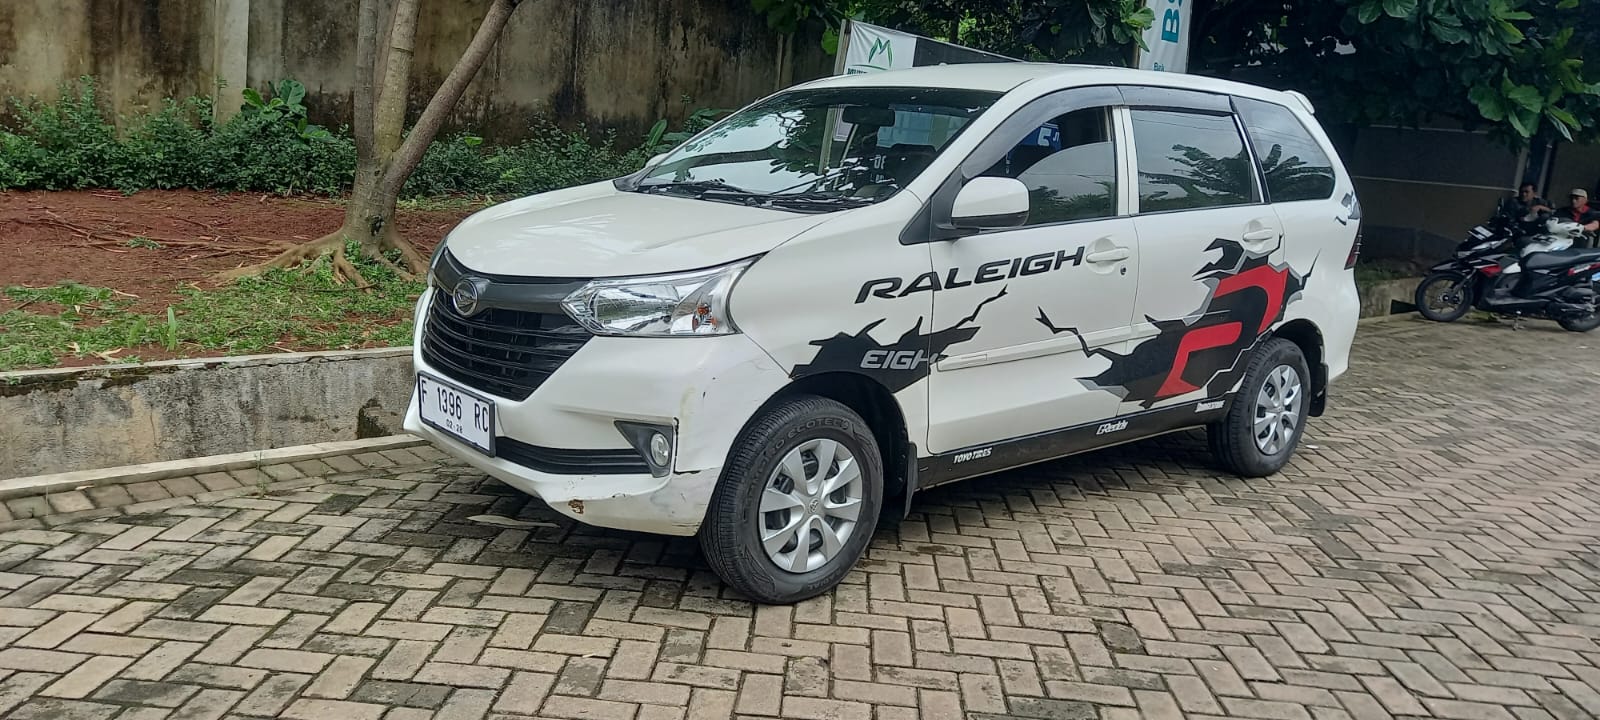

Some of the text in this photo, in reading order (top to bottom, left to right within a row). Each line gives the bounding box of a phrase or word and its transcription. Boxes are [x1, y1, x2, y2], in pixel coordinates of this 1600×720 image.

[854, 246, 1085, 304] RALEIGH
[421, 380, 489, 433] F 1396 RC
